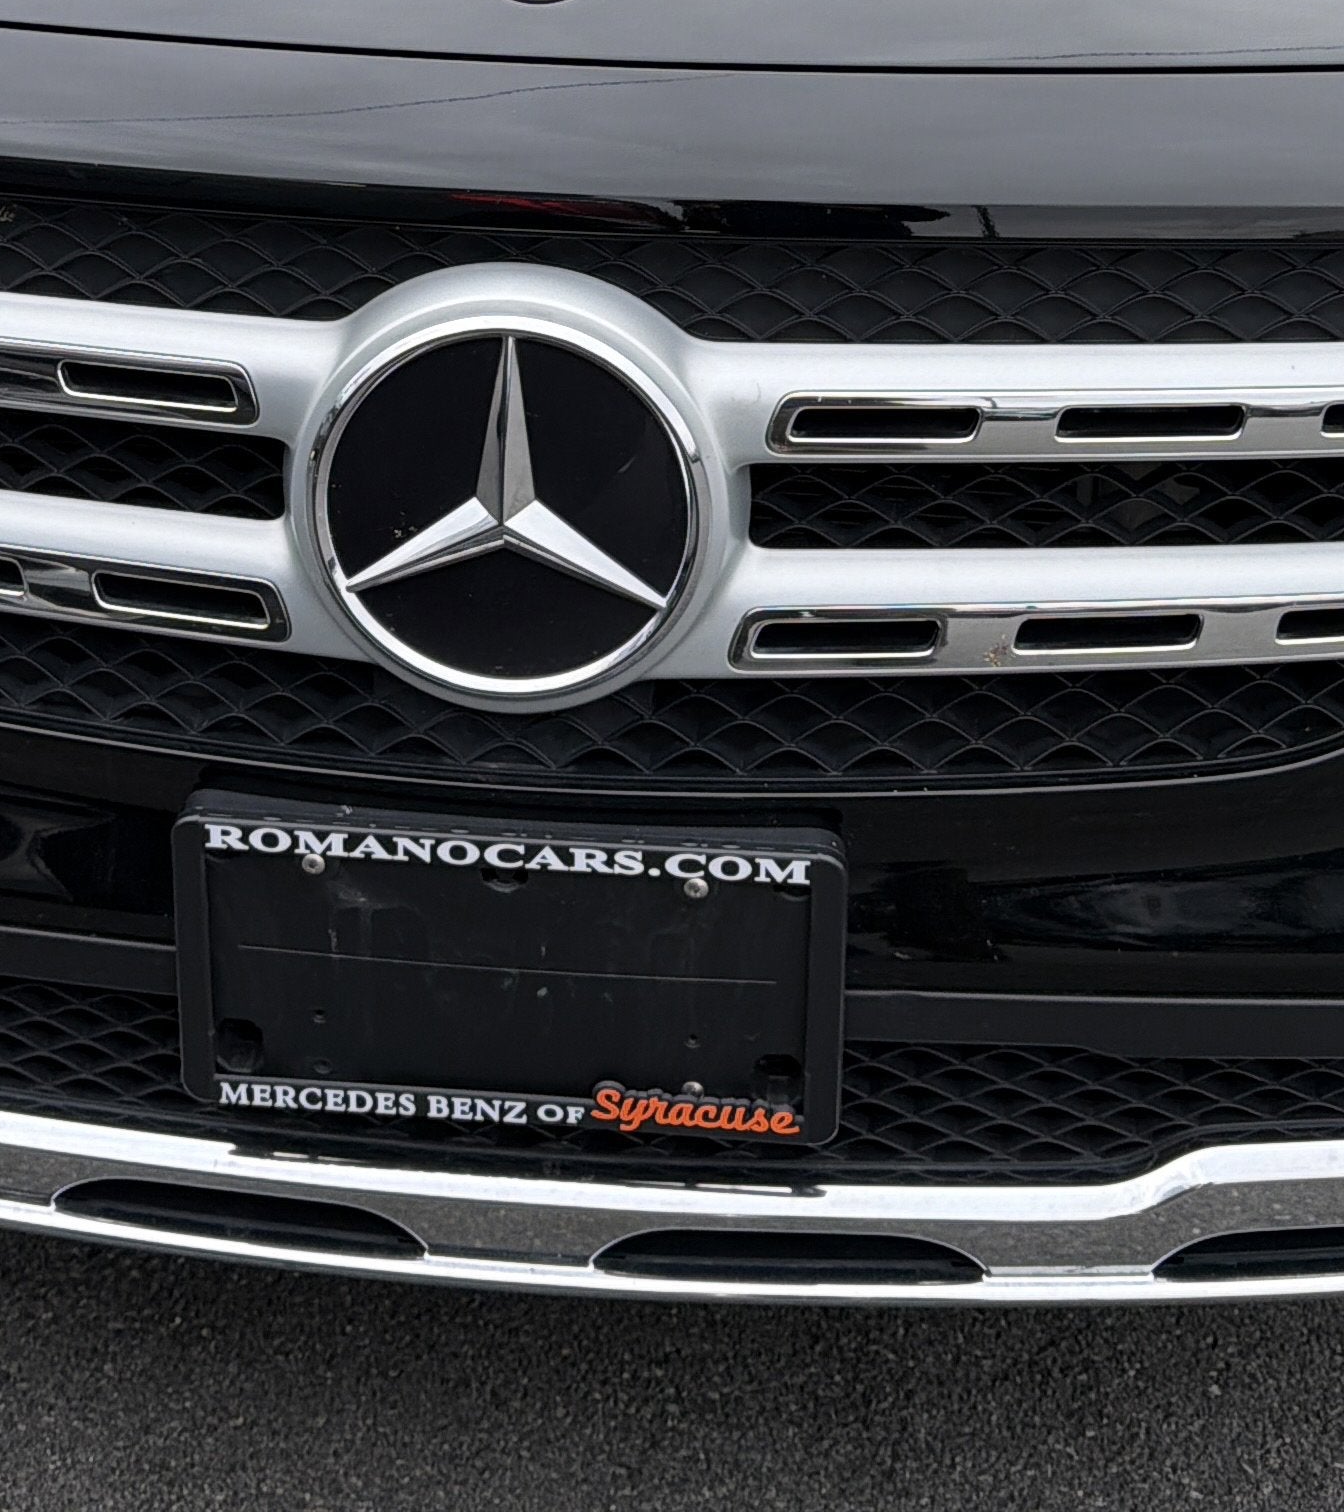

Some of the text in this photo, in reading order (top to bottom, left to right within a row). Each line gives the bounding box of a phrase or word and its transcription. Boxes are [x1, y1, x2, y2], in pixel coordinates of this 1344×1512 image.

[204, 823, 812, 886] ROMANOCARS.COM
[218, 1081, 801, 1134] MERCEDES BENZ OF Syracuse
